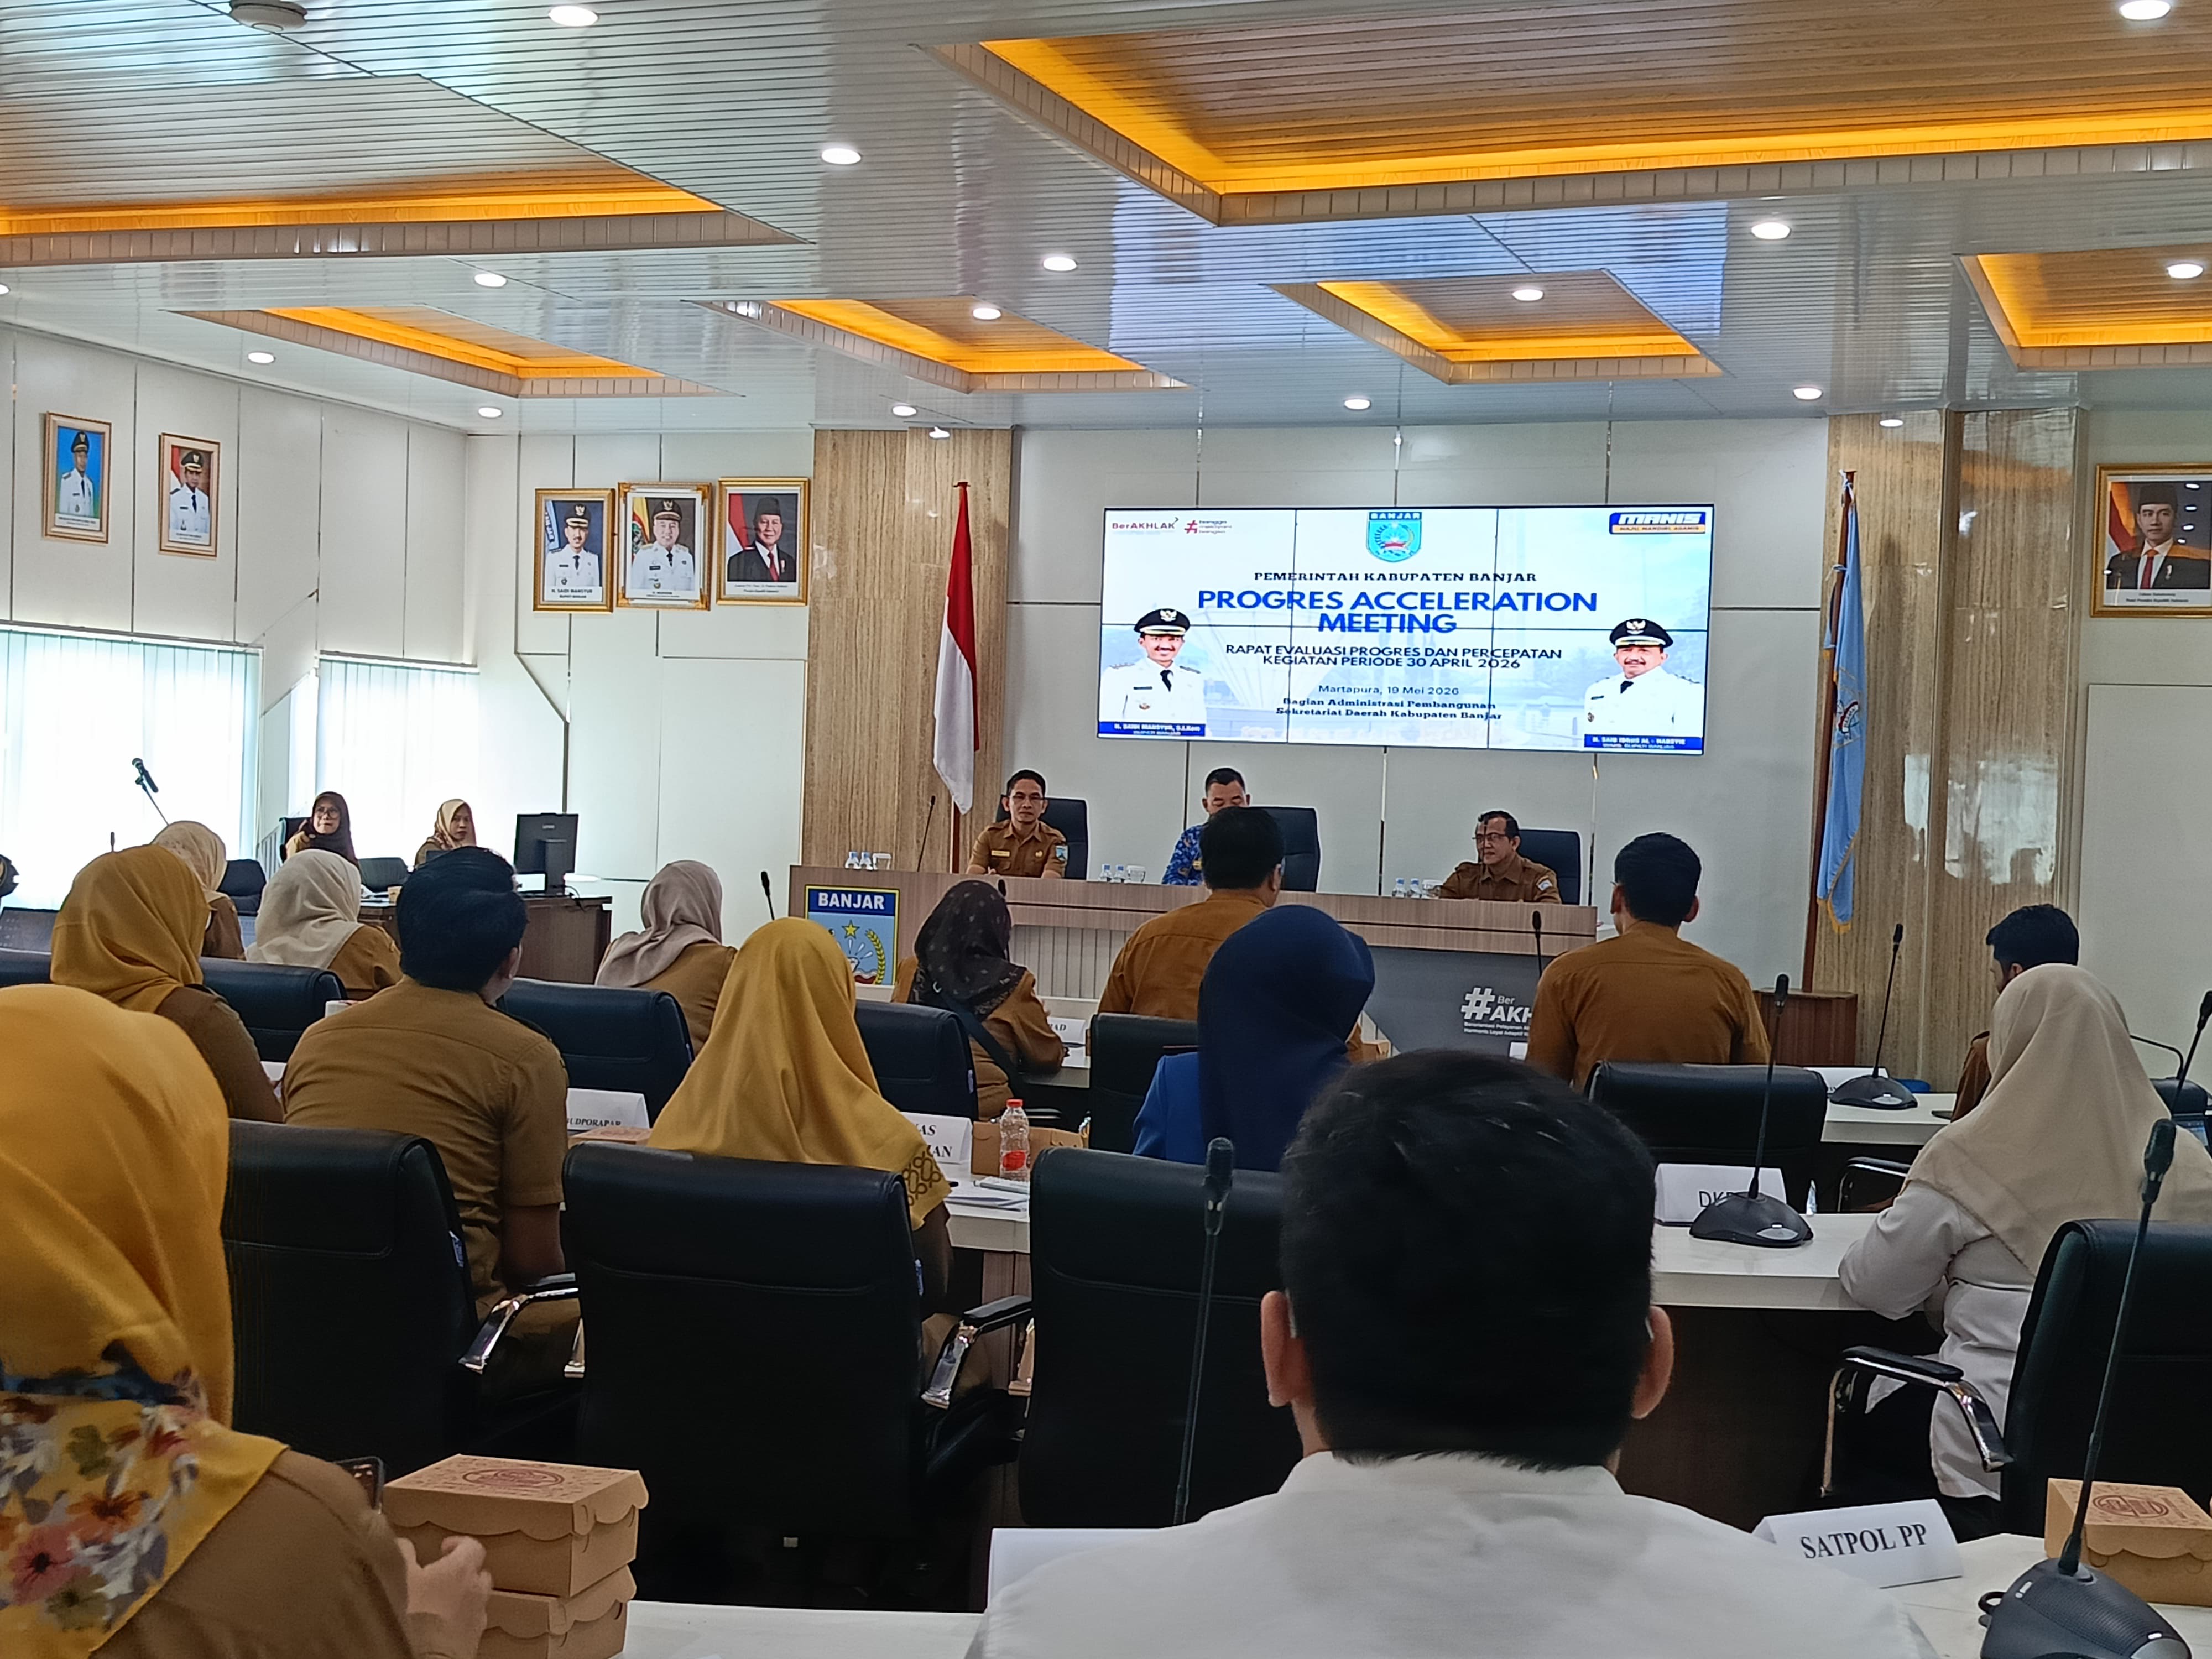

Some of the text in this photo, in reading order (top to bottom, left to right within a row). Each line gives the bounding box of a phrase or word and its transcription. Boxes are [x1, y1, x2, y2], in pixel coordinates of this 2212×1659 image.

[1618, 514, 1702, 524] MANIS
[1254, 572, 1537, 583] PEMERINTAH KABUPATEN BANJAR
[1198, 590, 1597, 611] PROGRES ACCELERATION
[1318, 613, 1457, 633] MEETING
[1226, 645, 1562, 659] RAPAT EVALUASI PROGRES DAN PERCEPATAN
[1263, 655, 1521, 669] KEGIATAN PERIODE 30 APRIL 2026
[1318, 685, 1383, 695] Martapura,
[1402, 686, 1424, 695] Mei
[1428, 687, 1459, 695] 2026
[1283, 698, 1496, 709] Bagian Administrasi Pembangunan
[1276, 708, 1342, 716] Sekretariat
[1391, 710, 1457, 719] Kabupaten
[1460, 712, 1502, 721] Banjar
[818, 892, 885, 910] BANJAR
[1497, 995, 1515, 1005] Ber
[1801, 1524, 1927, 1559] SATPOL PP
